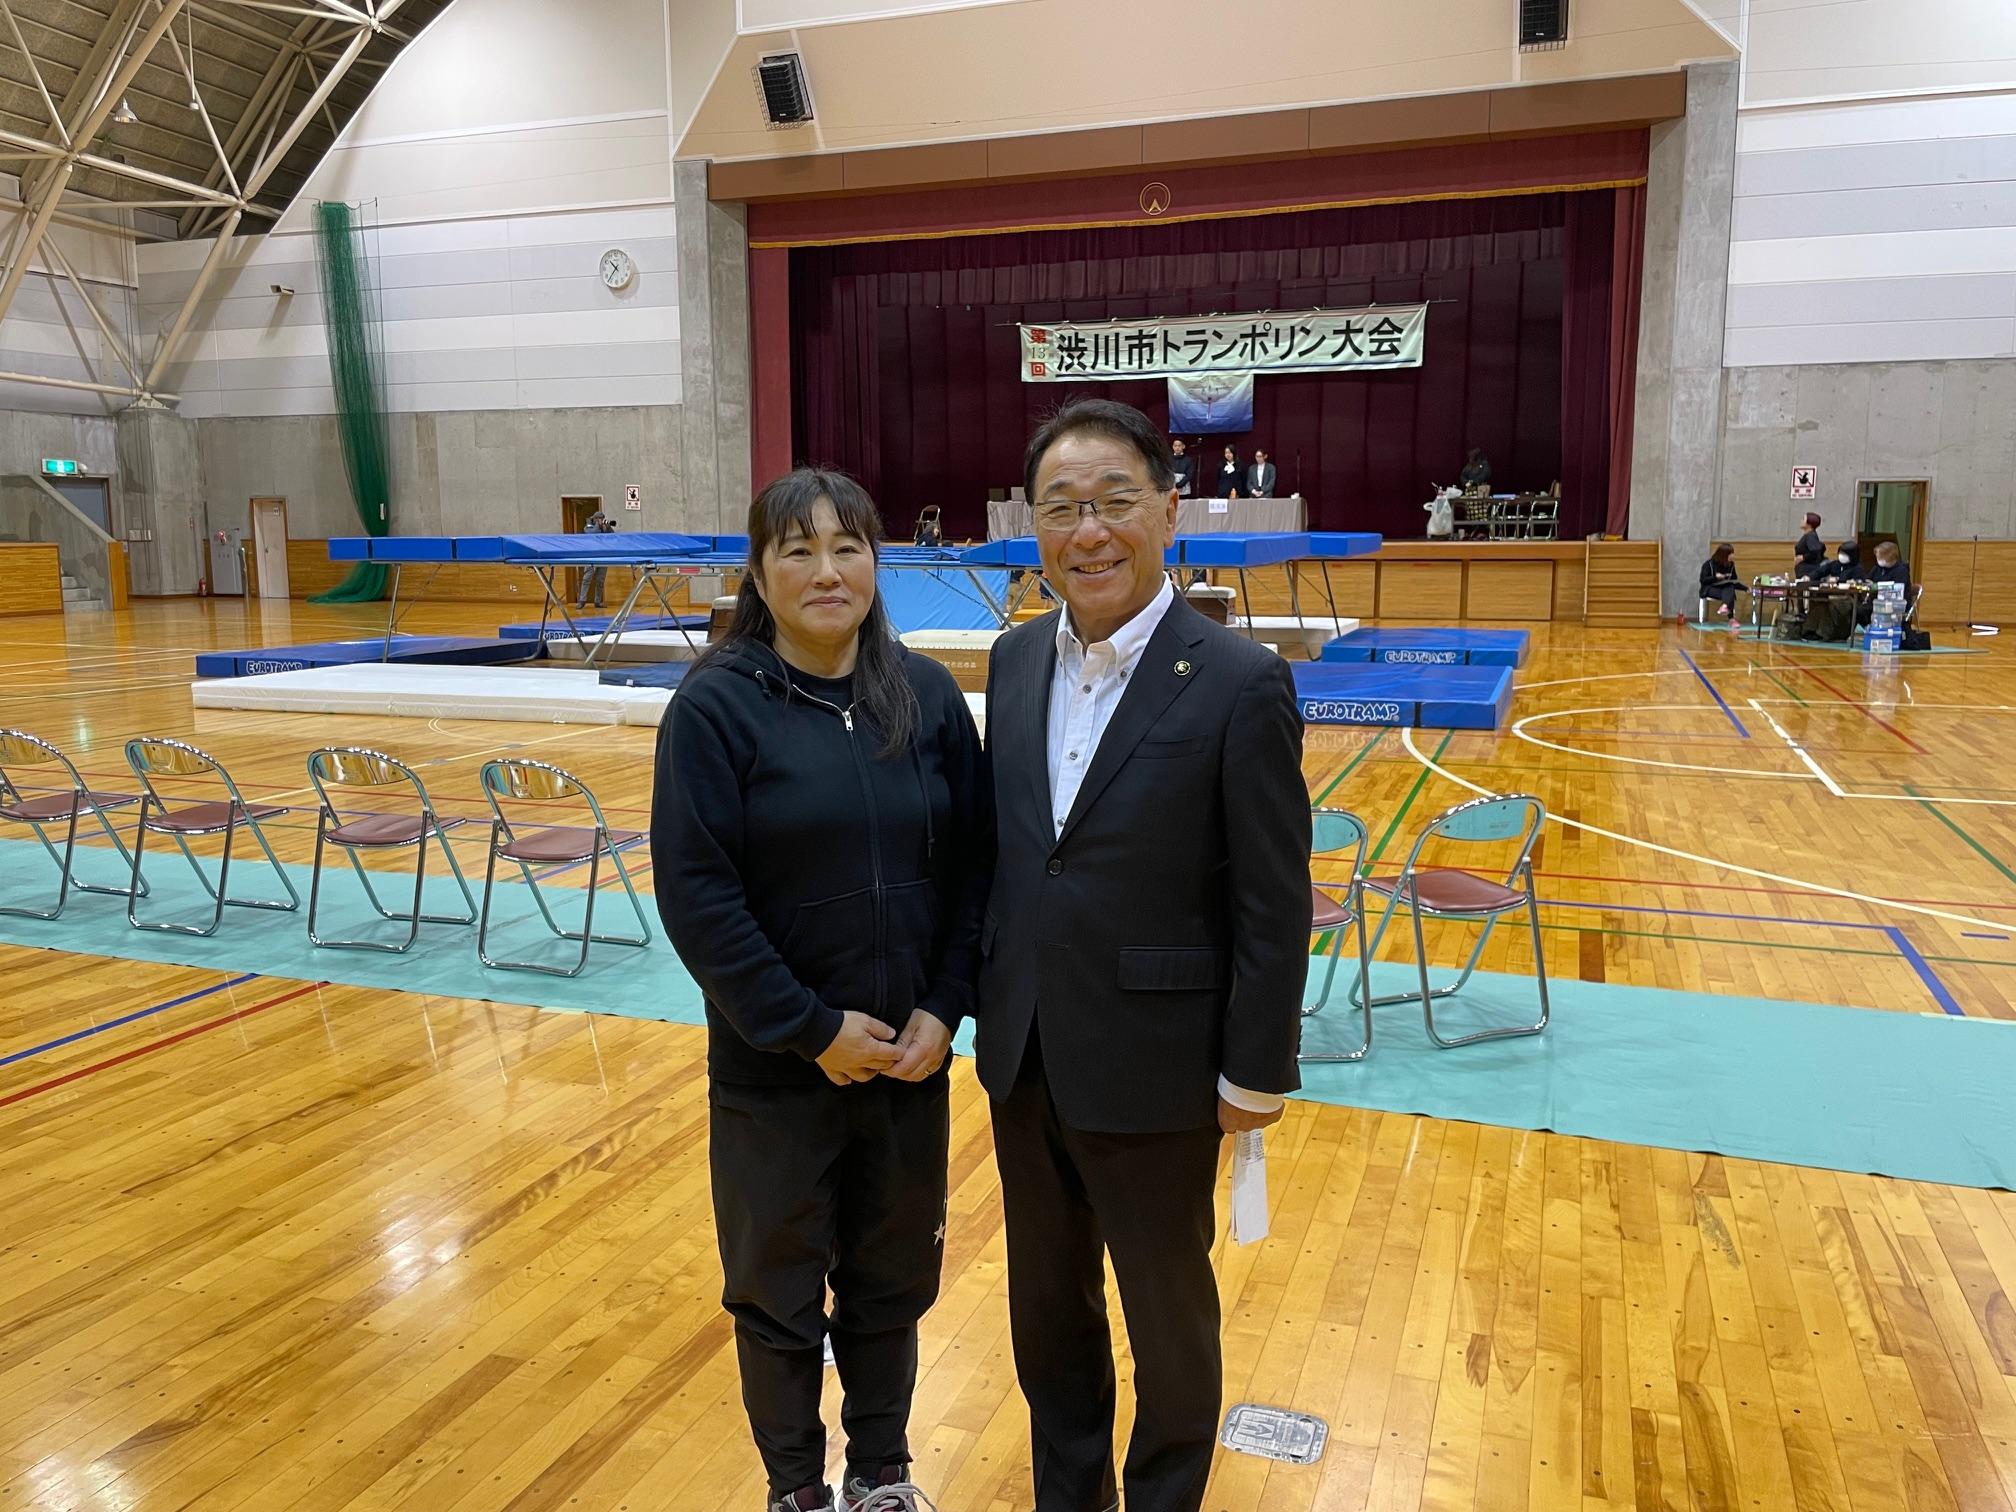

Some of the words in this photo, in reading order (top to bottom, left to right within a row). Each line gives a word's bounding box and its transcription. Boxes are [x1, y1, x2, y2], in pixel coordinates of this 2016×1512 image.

[1057, 317, 1404, 371] 渋川市トランポリン大会
[1384, 650, 1457, 664] EUROTRAMP
[1303, 702, 1399, 721] EUROTRAMP
